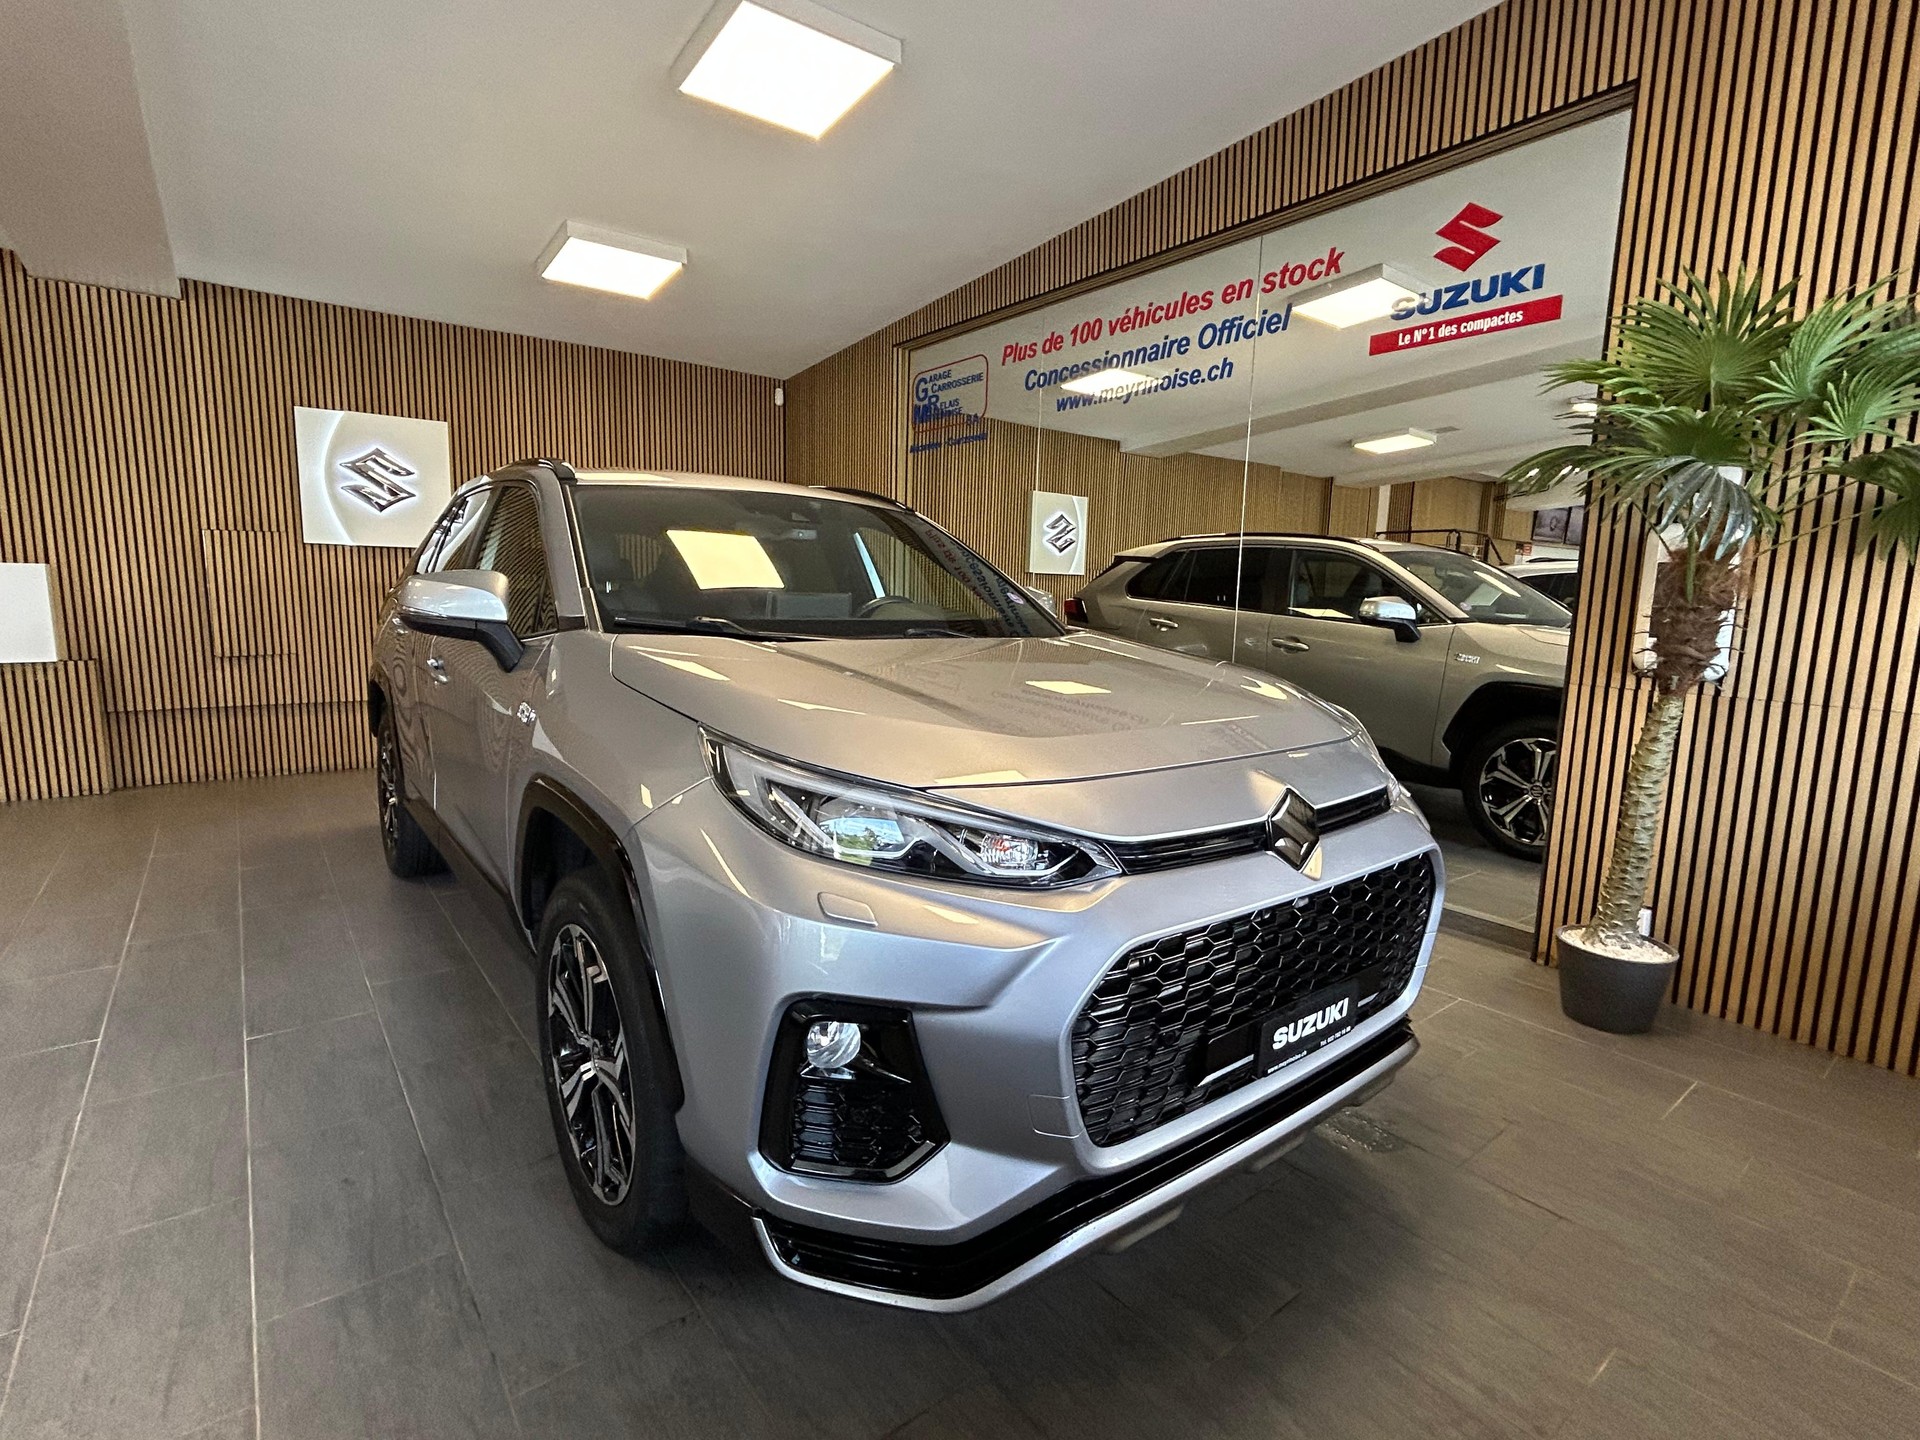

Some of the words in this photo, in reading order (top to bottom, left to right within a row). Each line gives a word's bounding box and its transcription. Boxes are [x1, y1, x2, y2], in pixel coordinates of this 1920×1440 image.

[1002, 342, 1037, 366] Plus
[1042, 332, 1063, 355] de
[1070, 318, 1103, 347] 100
[1109, 290, 1213, 336] véhicules
[1221, 278, 1254, 304] en
[1261, 247, 1345, 294] stock
[1391, 263, 1545, 320] SUZUKI
[1025, 336, 1190, 391] Concessionnaire
[1198, 303, 1293, 349] Officiel
[1398, 332, 1410, 347] Le
[1438, 322, 1457, 338] des
[1460, 310, 1523, 333] compactes
[1056, 357, 1234, 412] www.meyrinoise.ch
[1272, 997, 1349, 1050] SUZUKI
